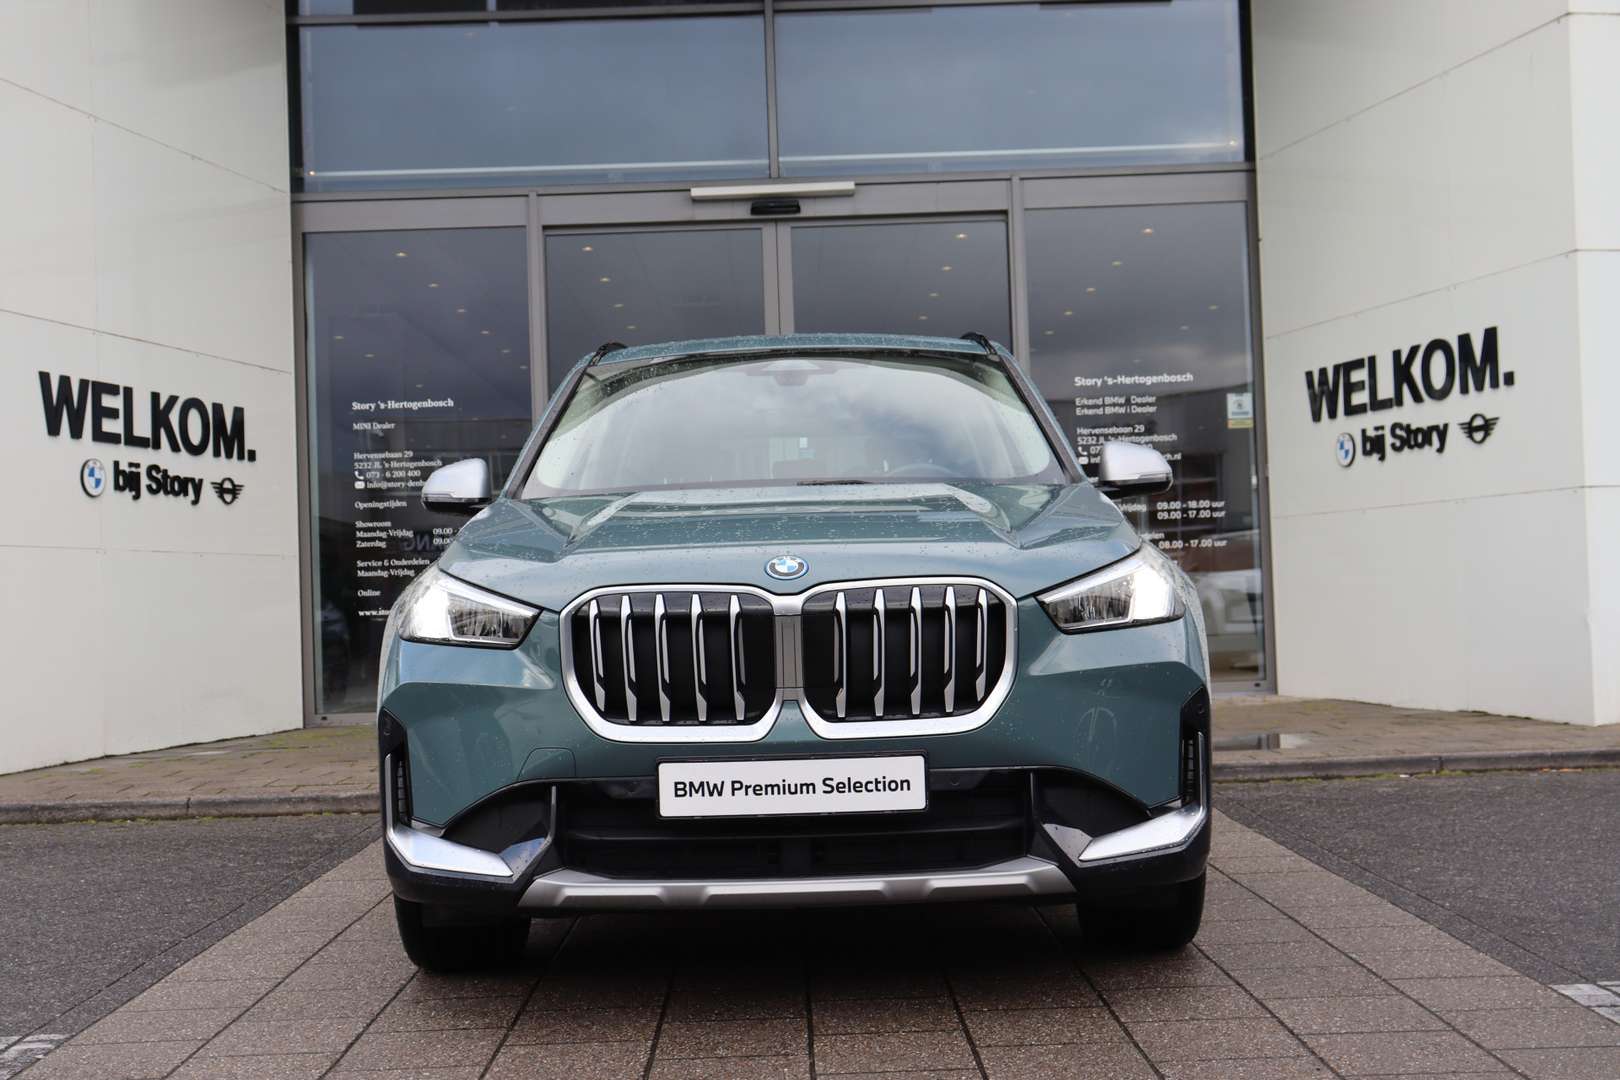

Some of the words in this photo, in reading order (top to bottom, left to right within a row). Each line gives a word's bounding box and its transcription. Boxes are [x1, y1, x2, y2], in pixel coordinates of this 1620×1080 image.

[1305, 326, 1515, 422] WELKOM.
[1074, 376, 1102, 387] Story
[1075, 397, 1102, 406] Erkend
[1104, 396, 1125, 405] BMW
[1131, 395, 1156, 403] Dealer
[352, 401, 376, 412] Story
[1076, 407, 1103, 416] Erkend
[1105, 406, 1126, 414] BMW
[1132, 404, 1157, 413] Dealer
[38, 370, 256, 462] WELKOM.
[373, 422, 395, 430] Dealer
[1134, 424, 1145, 433] 29
[1390, 422, 1449, 454] Story
[404, 450, 413, 458] 29
[146, 464, 203, 505] Story
[1157, 511, 1181, 520] 09.00
[357, 559, 382, 567] Service
[674, 781, 724, 797] BMW
[731, 779, 816, 796] Premium
[822, 776, 911, 794] Selection
